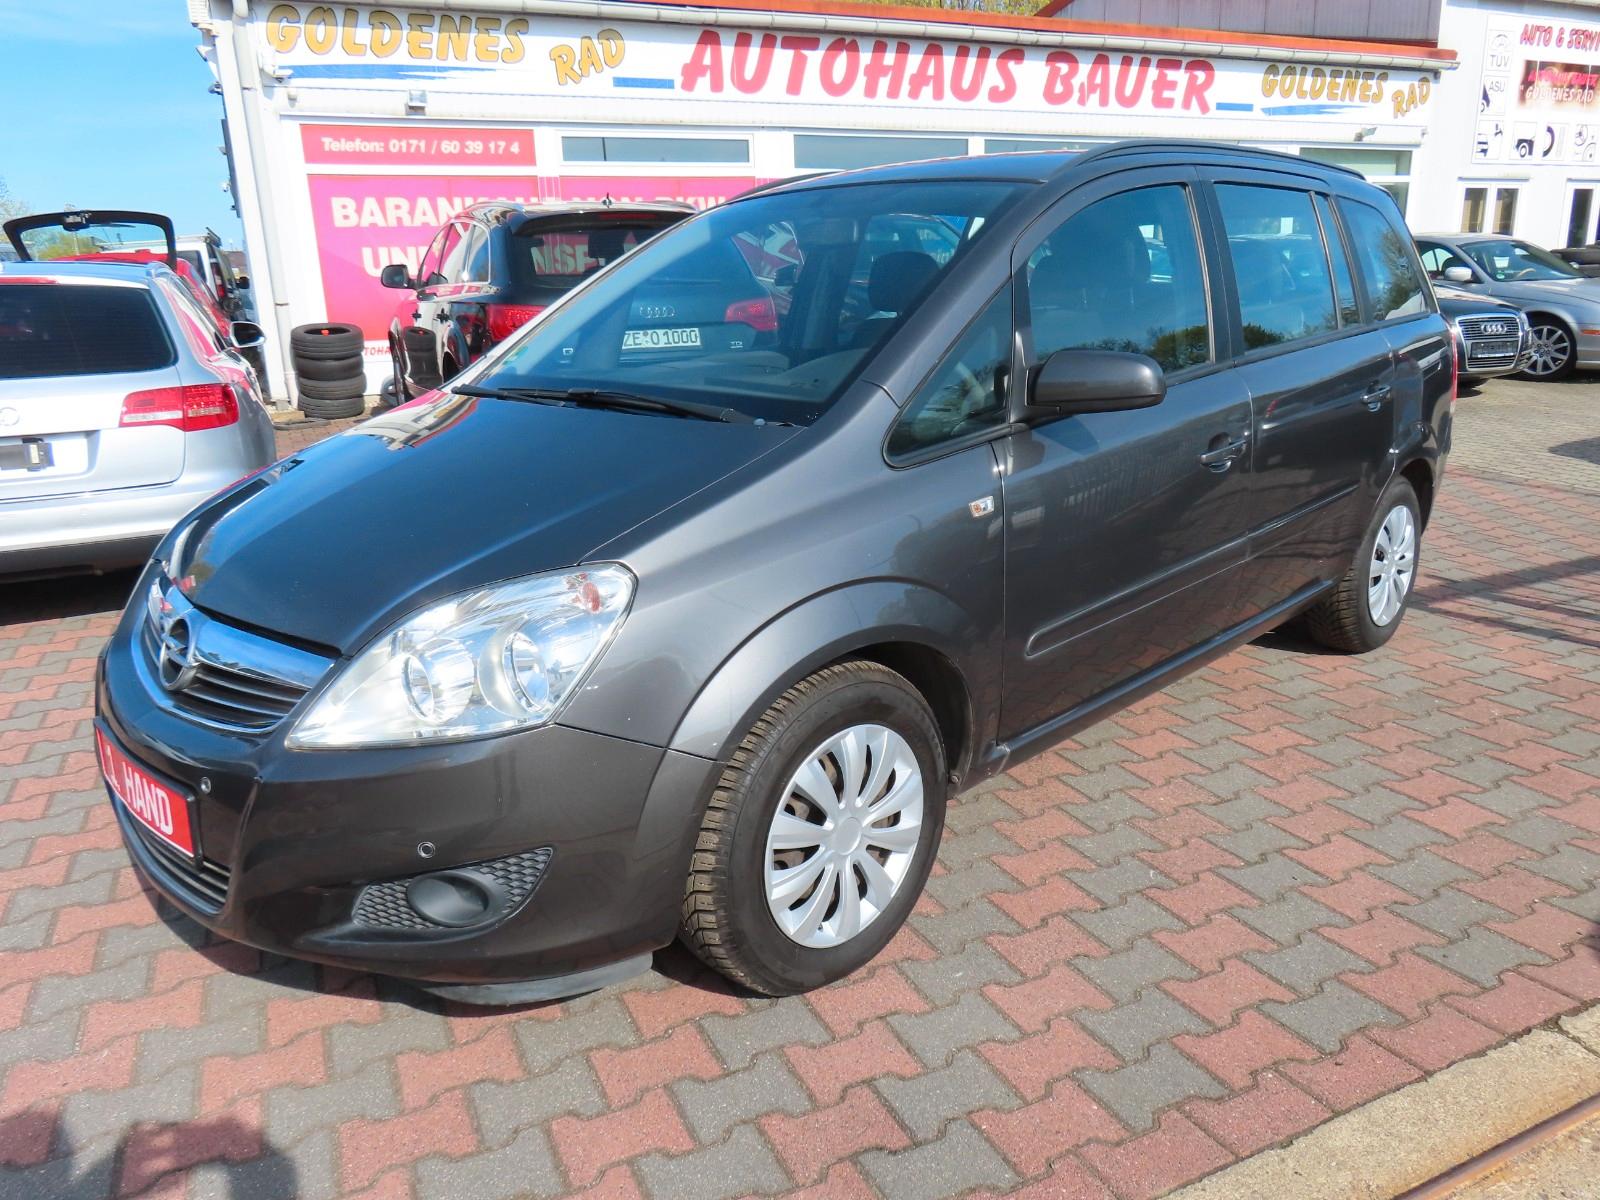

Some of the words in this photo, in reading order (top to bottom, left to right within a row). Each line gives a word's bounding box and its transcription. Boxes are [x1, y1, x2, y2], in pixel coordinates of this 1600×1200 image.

[265, 4, 530, 64] GOLDENES
[549, 27, 626, 87] RAD
[1520, 24, 1553, 47] AUTO
[1556, 27, 1566, 48] &
[681, 30, 1025, 103] AUTOHAUS
[1043, 51, 1216, 115] BAUER
[1262, 64, 1389, 103] GOLDENES
[1391, 77, 1431, 119] RAD
[321, 137, 385, 153] Telefon:
[389, 139, 426, 154] 0171
[431, 140, 437, 154] /
[441, 140, 461, 154] 60
[464, 140, 483, 155] 39
[488, 141, 506, 155] 17
[509, 142, 520, 155] 4
[623, 332, 642, 347] ZE
[663, 329, 699, 345] 1000
[122, 761, 174, 835] HAND
